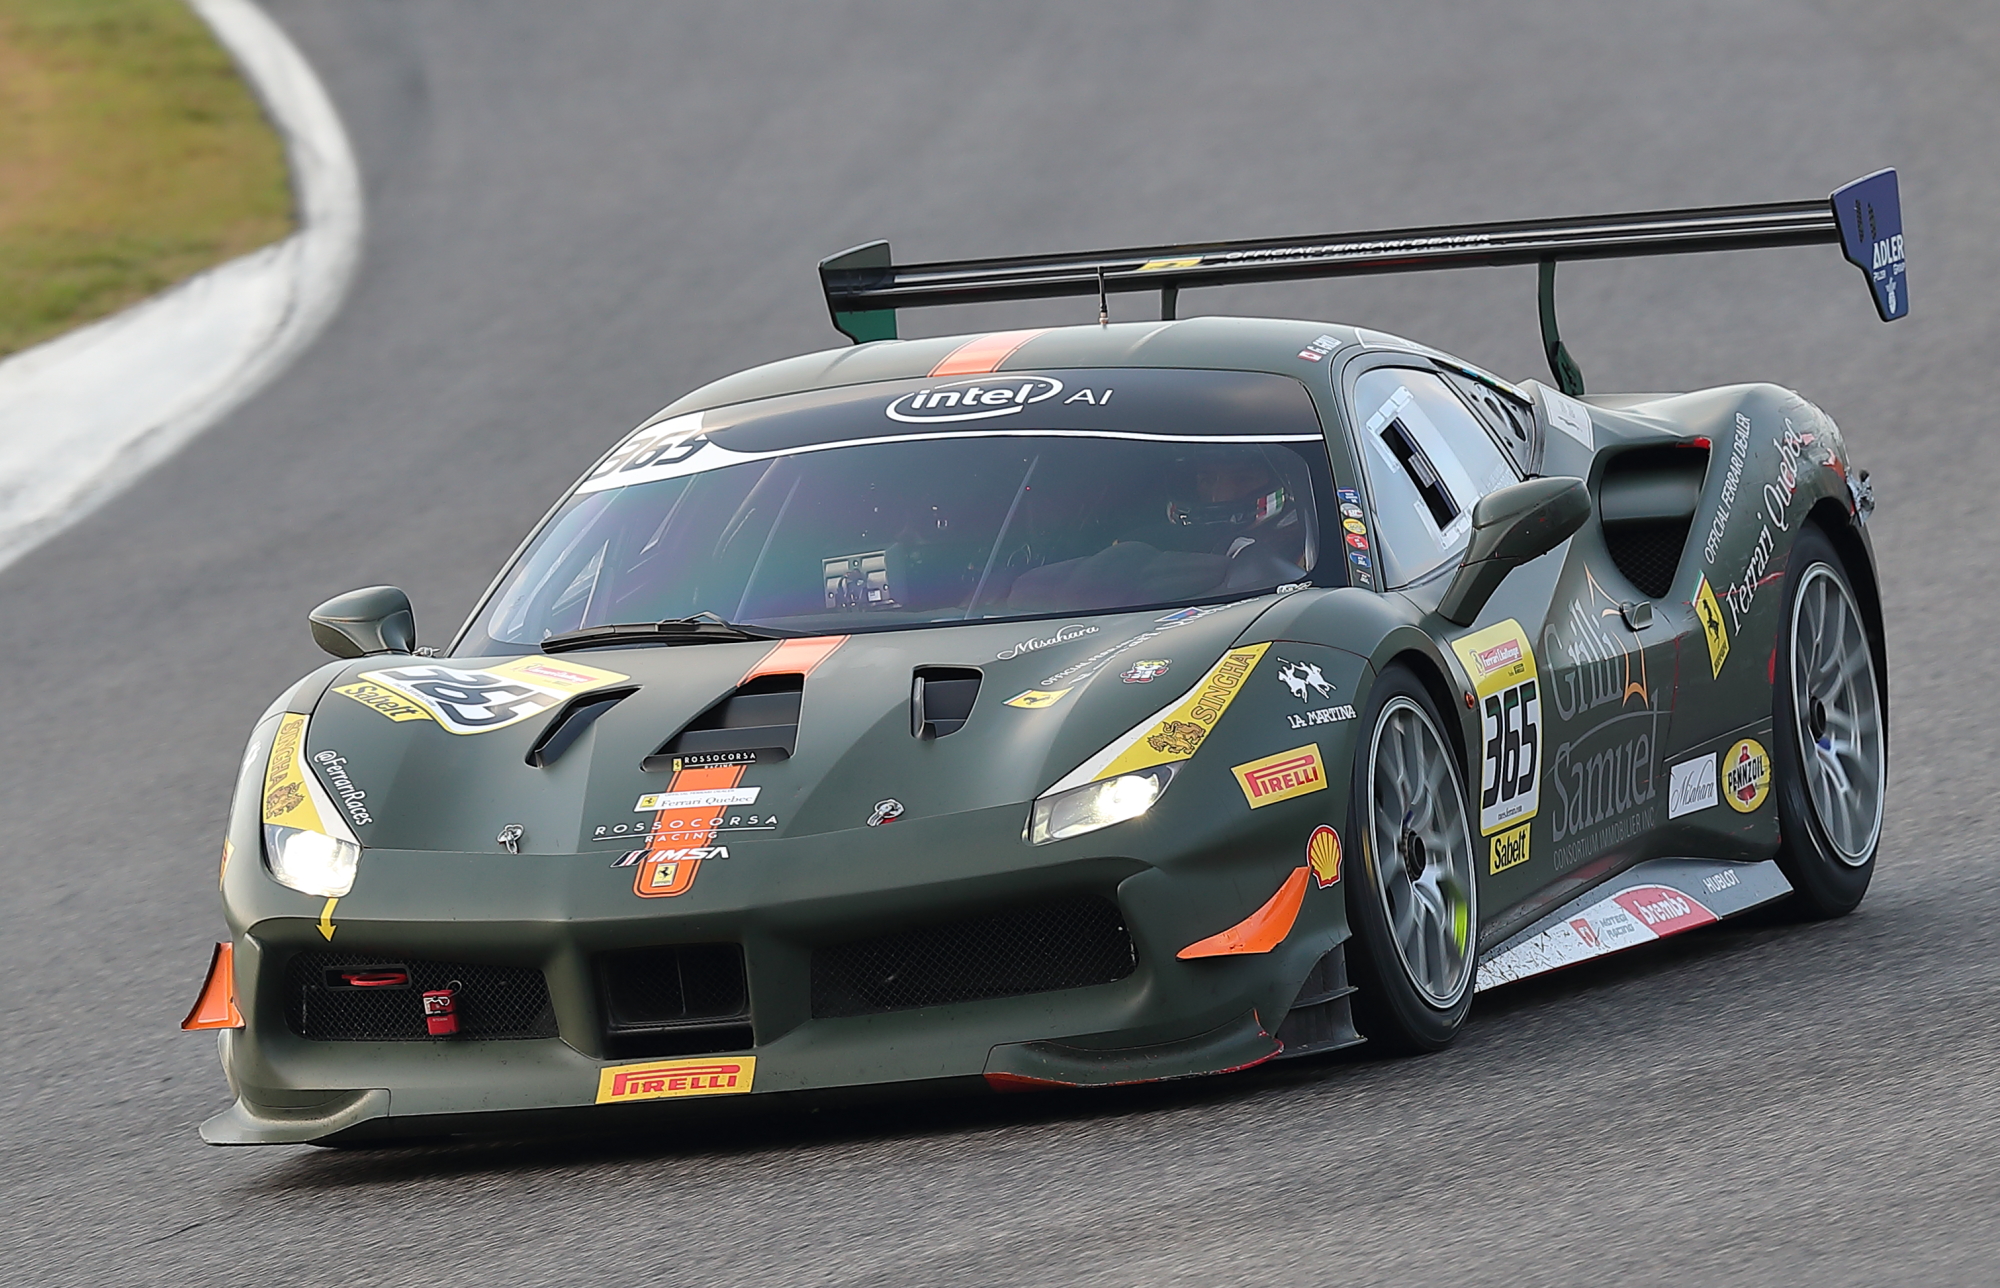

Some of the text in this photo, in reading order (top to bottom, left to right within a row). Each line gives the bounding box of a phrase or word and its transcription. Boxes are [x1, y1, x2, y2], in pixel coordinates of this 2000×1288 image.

[1226, 234, 1490, 259] OFFICIAL FERRARI DEALER
[1873, 234, 1904, 269] ADLER
[911, 383, 1114, 409] intel AI
[1704, 412, 1750, 564] OFFICIAL FERRARI DEALER
[1725, 417, 1802, 636] Ferrari Quebec
[997, 624, 1099, 660] Misahara
[344, 685, 418, 717] Sabelt
[380, 669, 561, 726] 365
[1191, 653, 1256, 725] SINGHA
[1307, 704, 1357, 726] MARTINA
[268, 719, 304, 792] SINGHA
[684, 752, 756, 763] ROSSOCORSA
[1482, 680, 1537, 810] 365
[1244, 754, 1319, 798] PIRELLI
[1552, 689, 1660, 842] Samuel
[1727, 754, 1765, 794] PENNZOIL
[313, 750, 373, 825] @FerrariRaces
[661, 796, 753, 807] Ferrari Quebec
[594, 815, 778, 836] ROSSOCORSA
[645, 832, 718, 843] RACING
[1553, 806, 1655, 870] CONSORTIUM IMMOBILIER INC
[648, 846, 729, 863] IMSA
[1494, 829, 1526, 870] Sabelt
[1702, 869, 1741, 894] HUBLOT
[1633, 892, 1691, 925] brembo
[611, 1065, 741, 1096] PIRELLI
